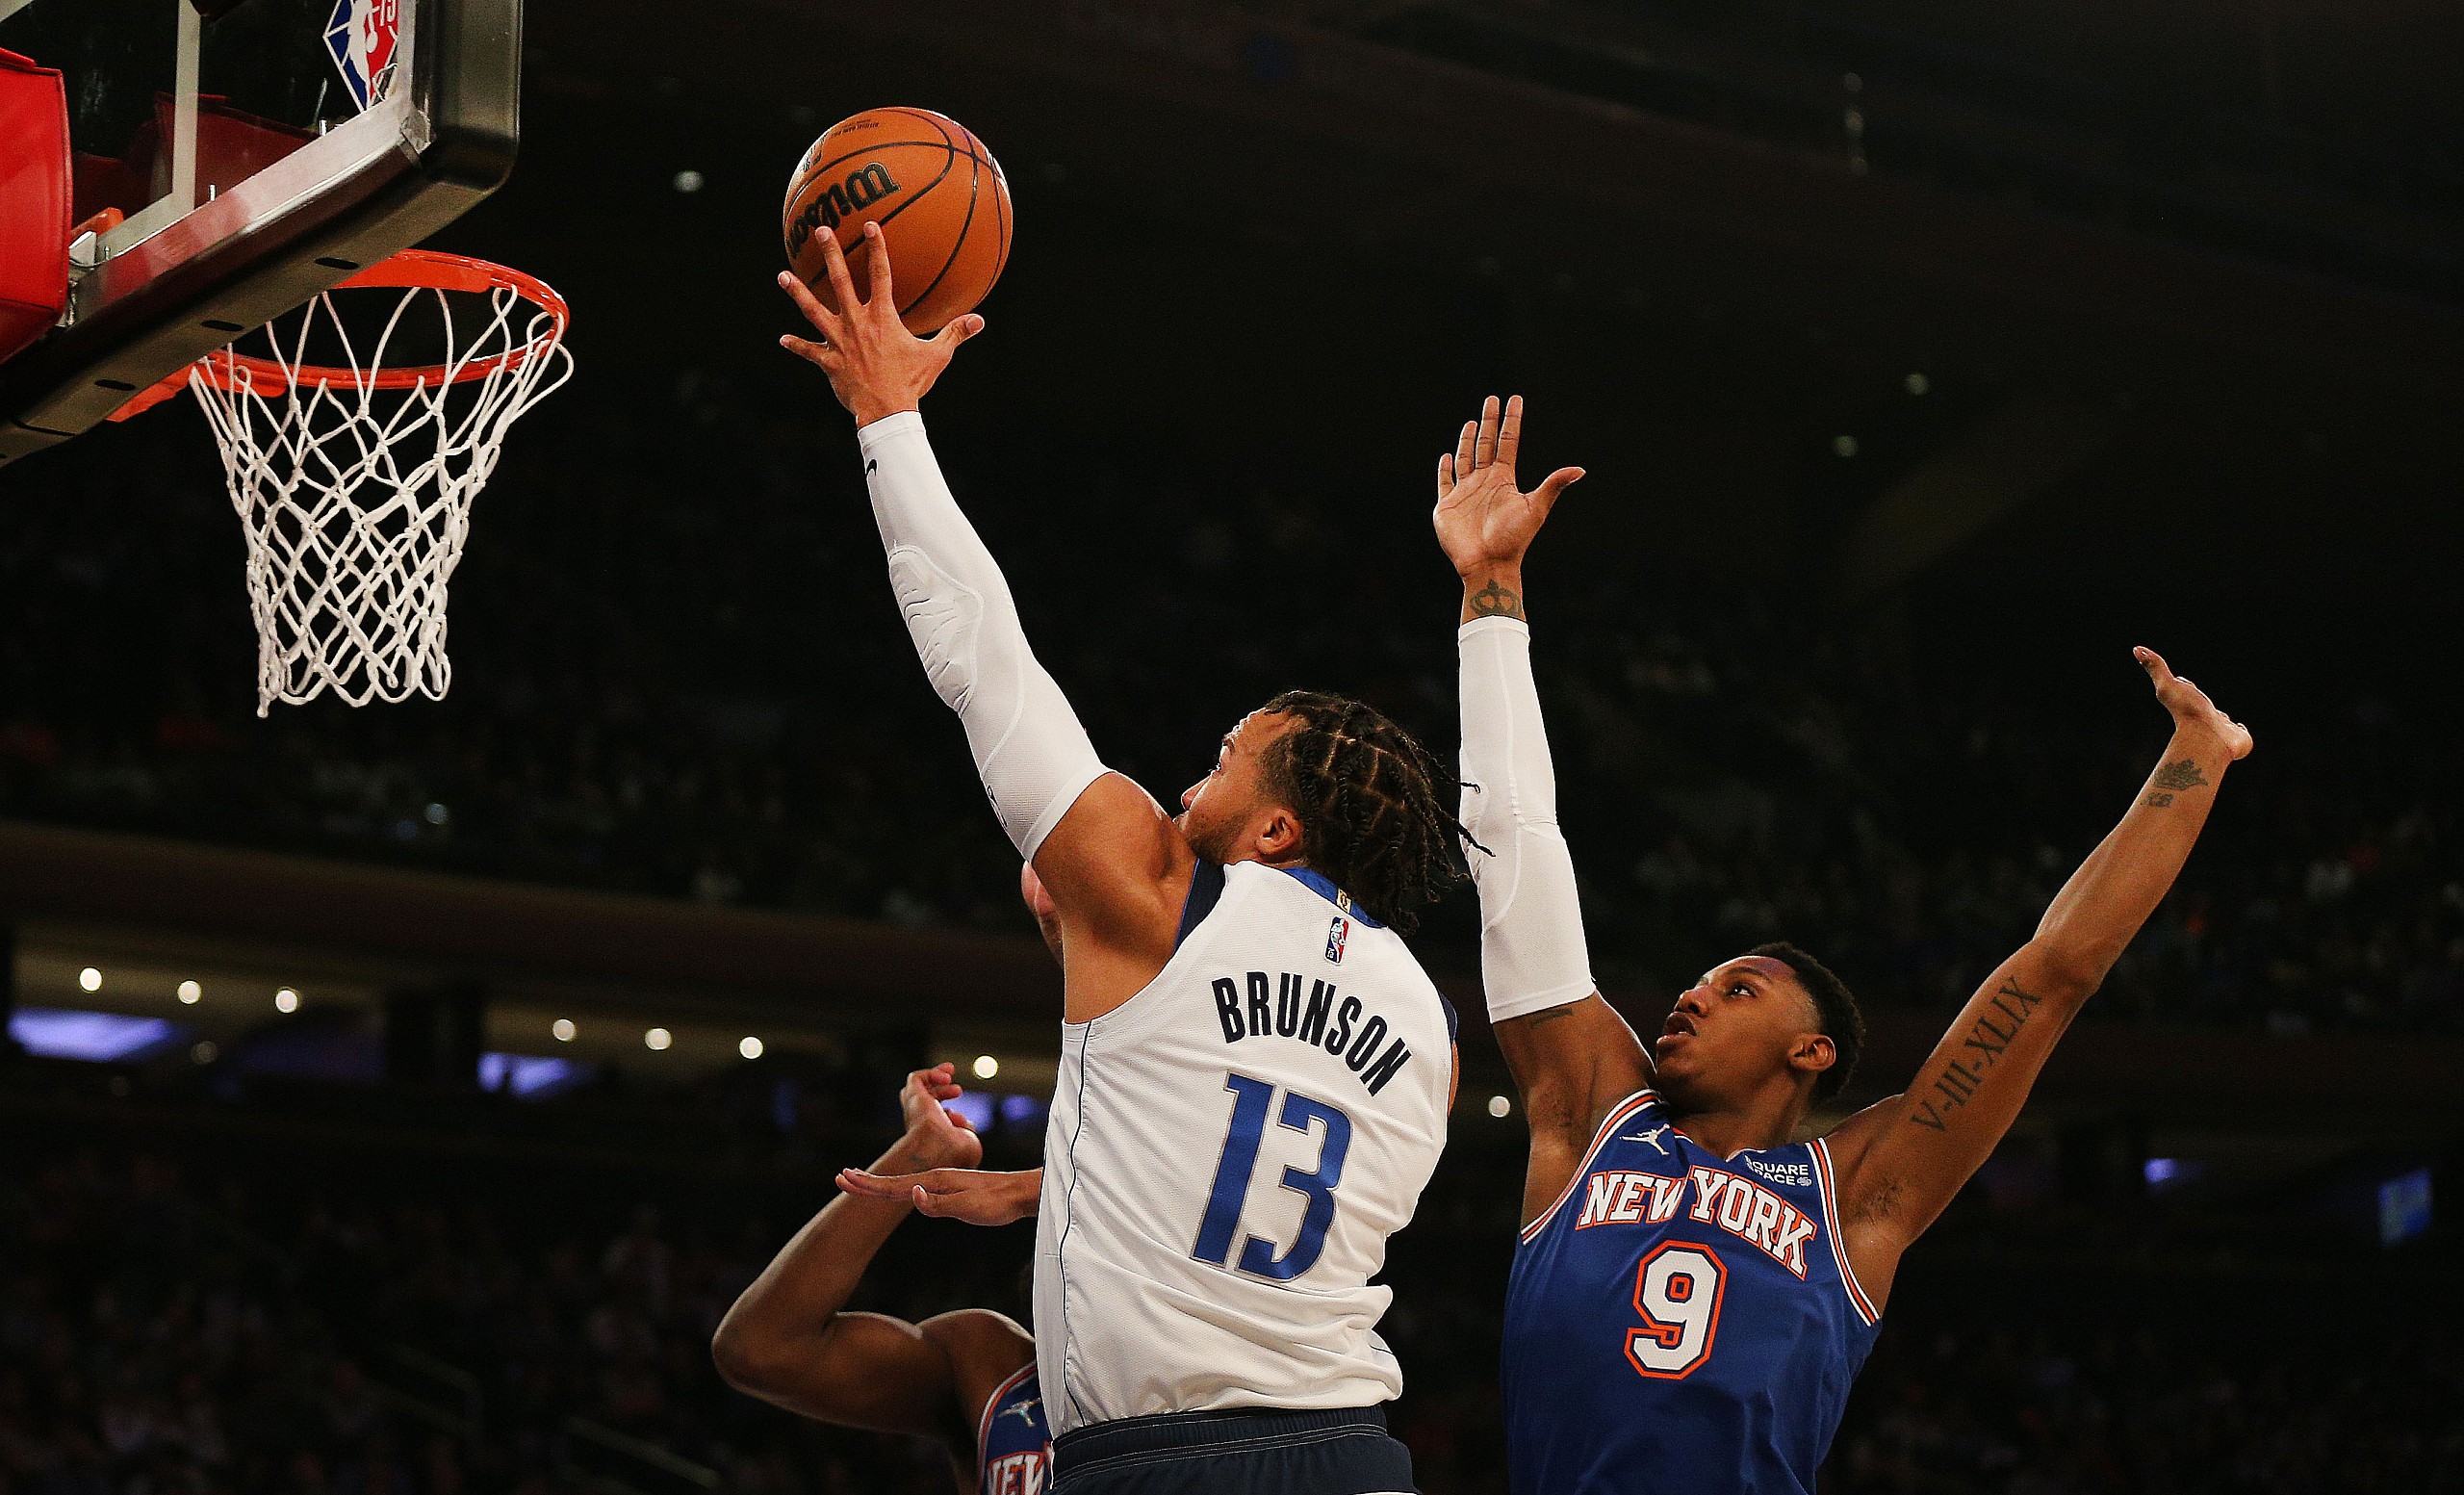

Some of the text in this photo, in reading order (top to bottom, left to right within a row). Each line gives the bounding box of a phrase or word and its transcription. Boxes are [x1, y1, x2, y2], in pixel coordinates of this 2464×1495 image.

[1211, 971, 1412, 1096] BRUNSON
[1910, 974, 2042, 1132] V-III-XLIX
[1190, 1070, 1354, 1283] 13
[1576, 1164, 1818, 1281] NEW YORK
[1624, 1239, 1729, 1380] 9
